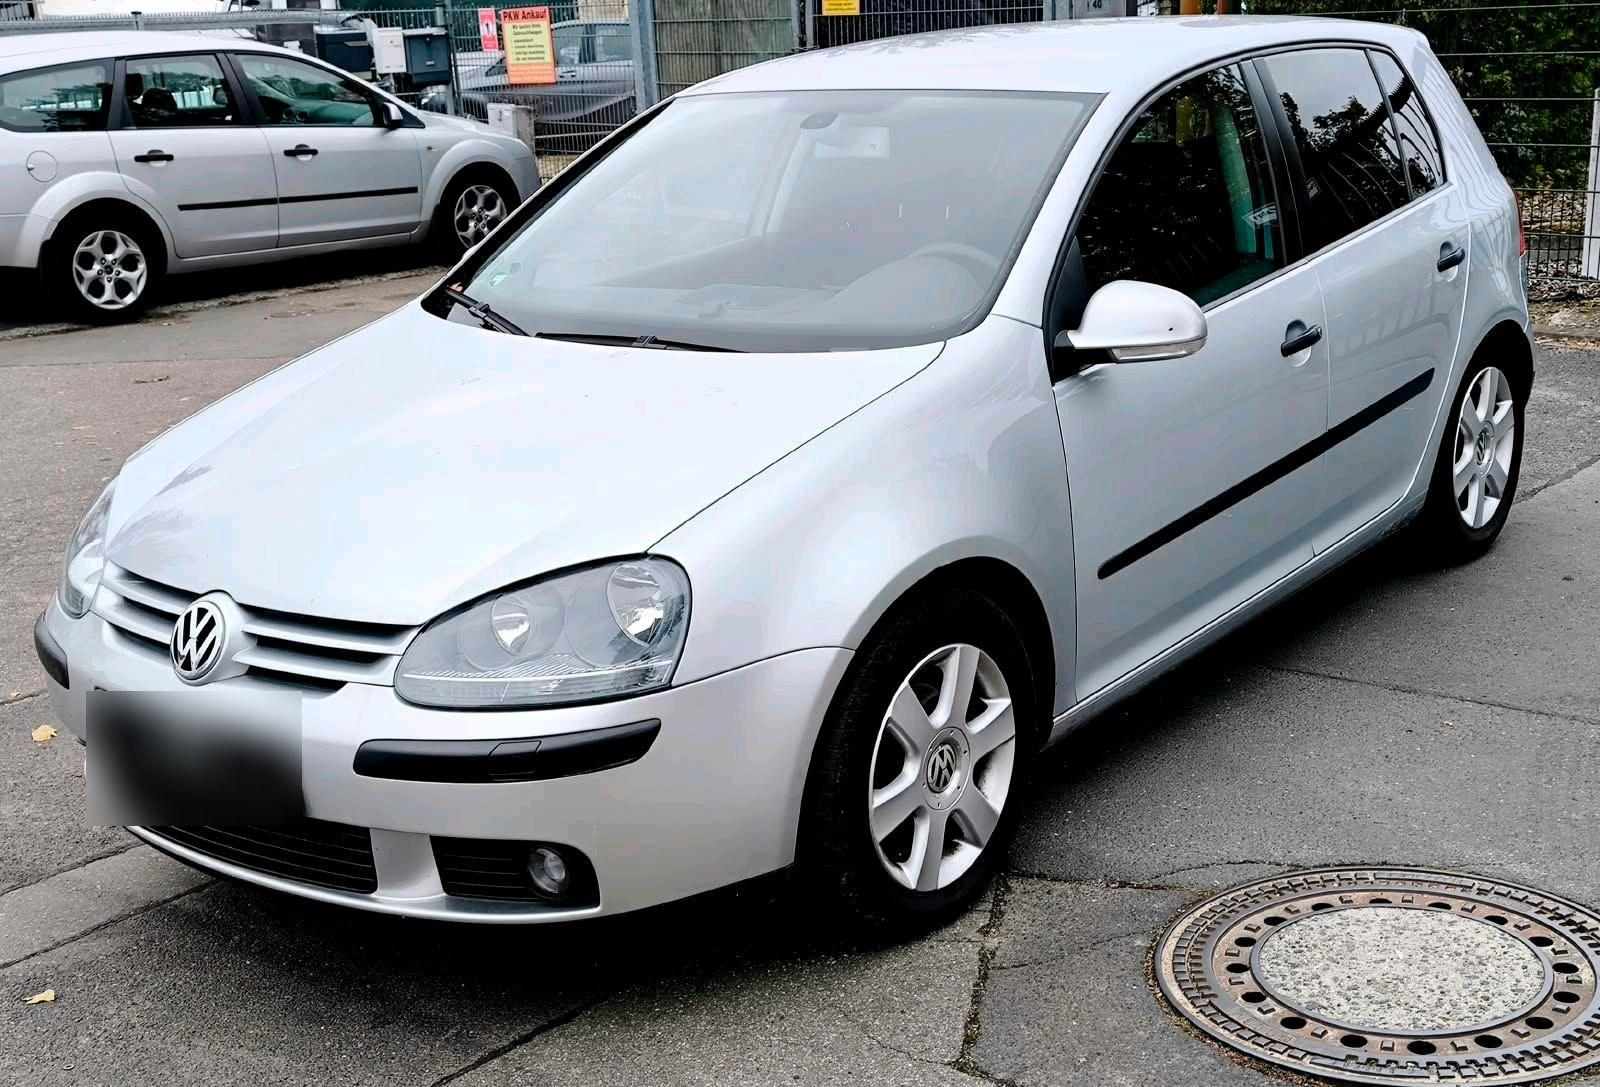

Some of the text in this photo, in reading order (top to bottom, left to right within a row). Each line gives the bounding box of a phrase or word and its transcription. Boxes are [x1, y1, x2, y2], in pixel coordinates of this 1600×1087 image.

[503, 8, 547, 21] PKW Ankauf
[172, 603, 221, 677] VW
